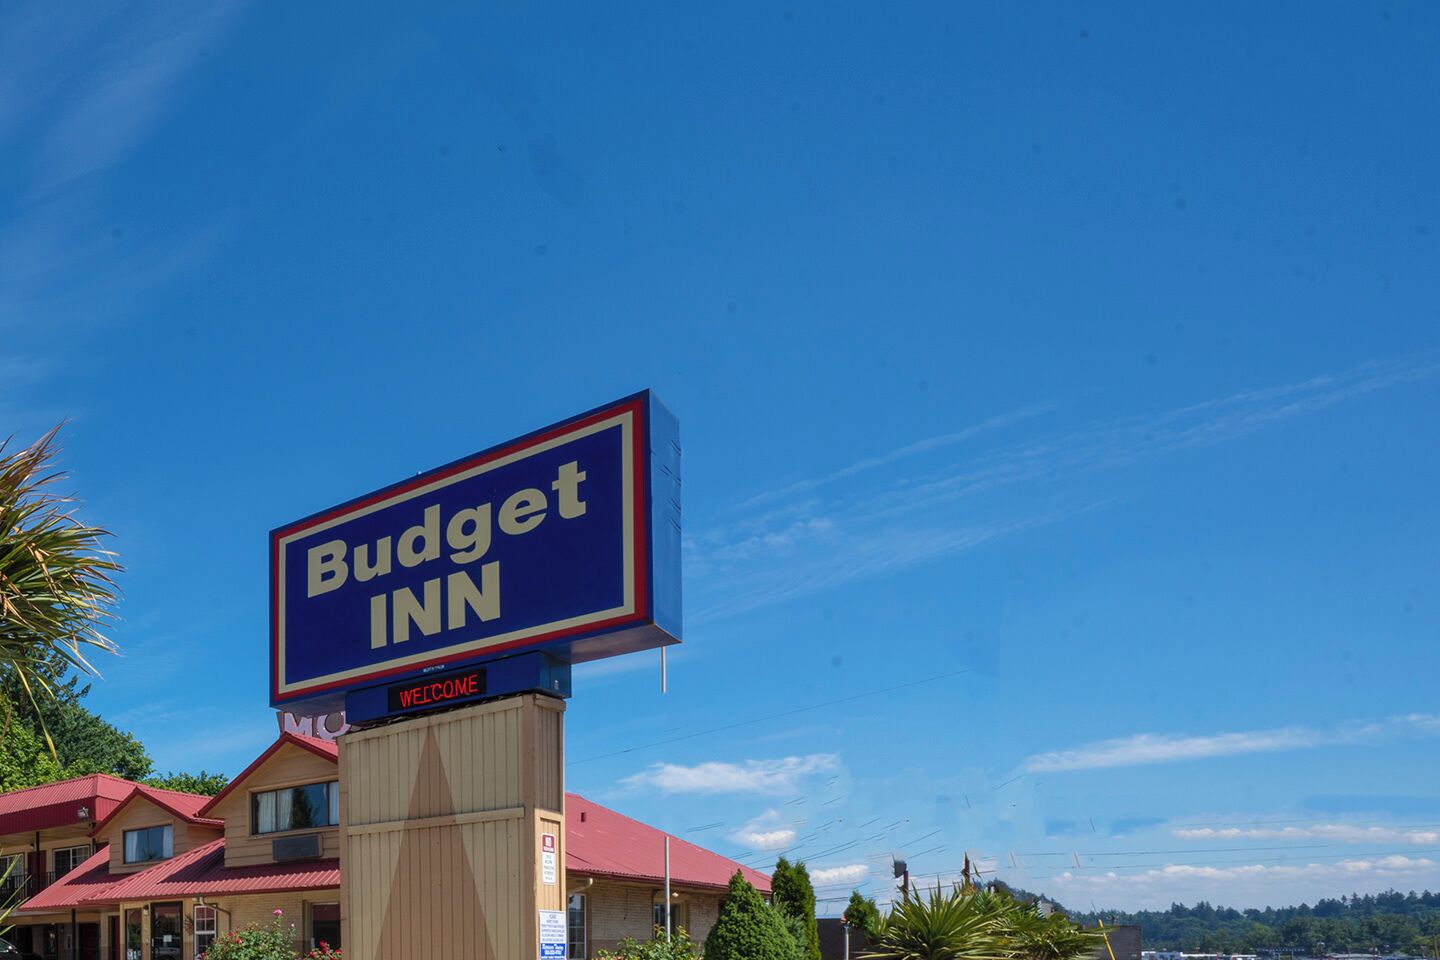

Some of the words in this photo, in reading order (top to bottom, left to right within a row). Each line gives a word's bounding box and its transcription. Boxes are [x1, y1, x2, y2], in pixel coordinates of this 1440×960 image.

[307, 460, 587, 598] Budget
[370, 560, 501, 650] INN
[399, 674, 479, 708] WELCOME
